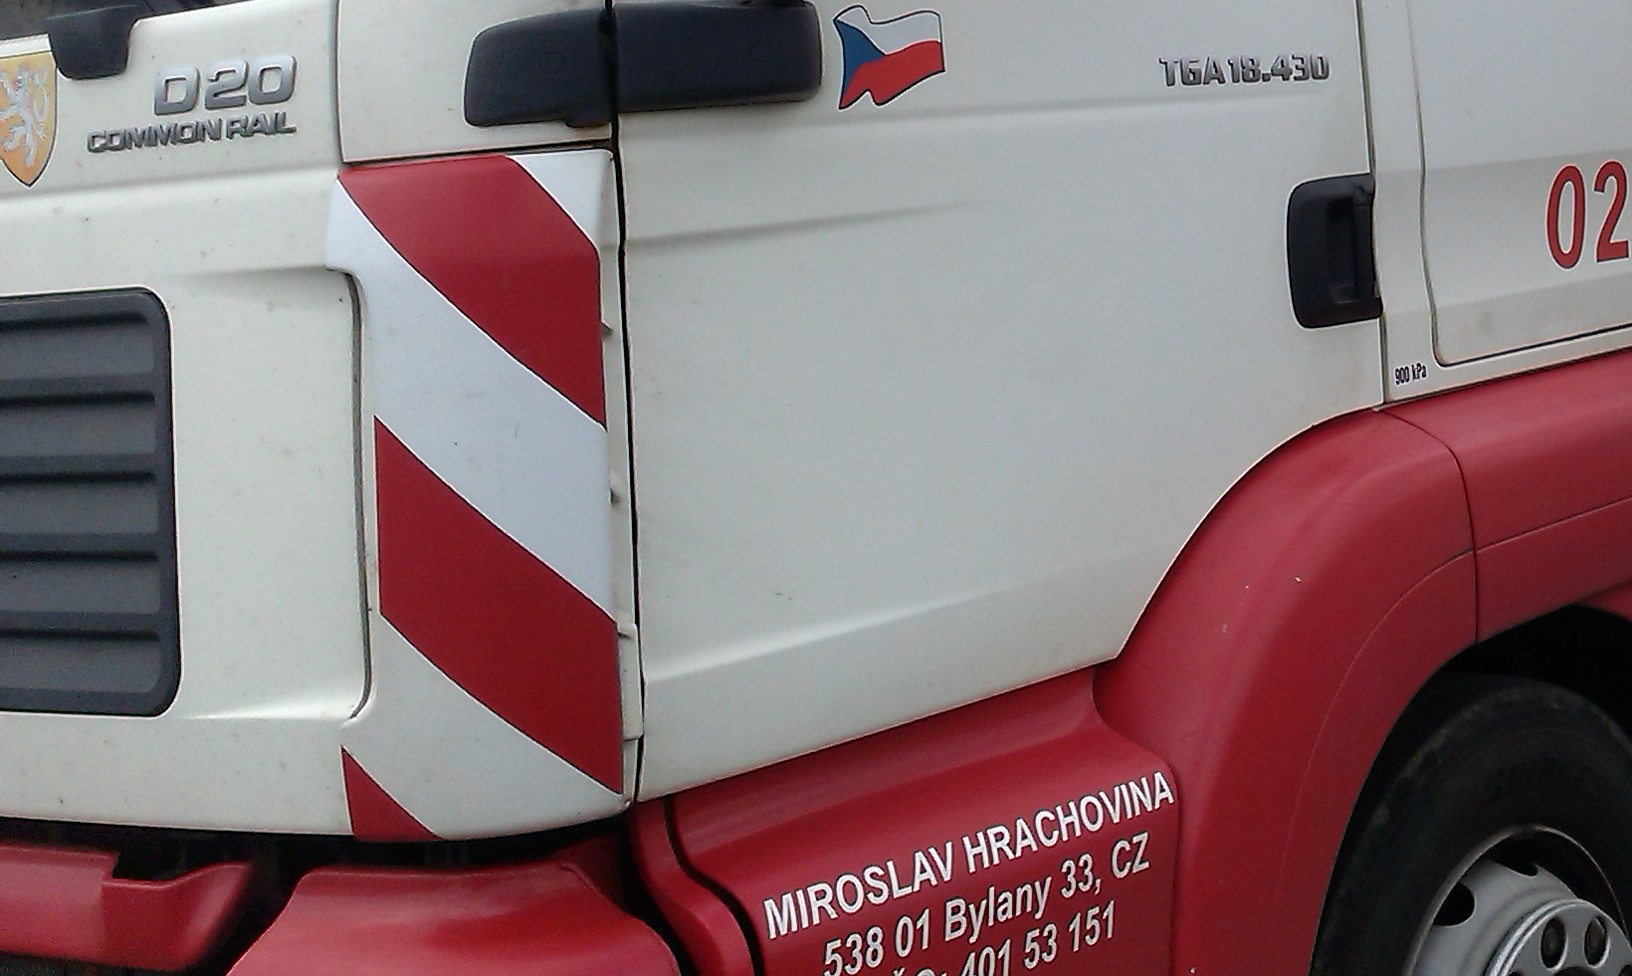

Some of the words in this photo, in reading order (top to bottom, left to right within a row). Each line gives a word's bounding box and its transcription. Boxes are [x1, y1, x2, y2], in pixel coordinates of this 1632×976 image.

[154, 55, 297, 115] D20
[87, 118, 222, 153] COMMON
[226, 111, 297, 139] RAIL
[1546, 160, 1629, 269] 02
[1395, 367, 1410, 385] 900
[1411, 362, 1427, 381] kPa
[763, 842, 954, 940] MIROSLAV
[962, 771, 1175, 874] HRACHOVINA
[824, 927, 884, 976] 538
[896, 909, 930, 957] 01
[945, 876, 1052, 944] Bylany
[1060, 853, 1101, 899] 33,
[1111, 832, 1150, 880] CZ
[961, 938, 1011, 976] 401
[1024, 923, 1058, 969] 53
[1069, 900, 1115, 952] 151
